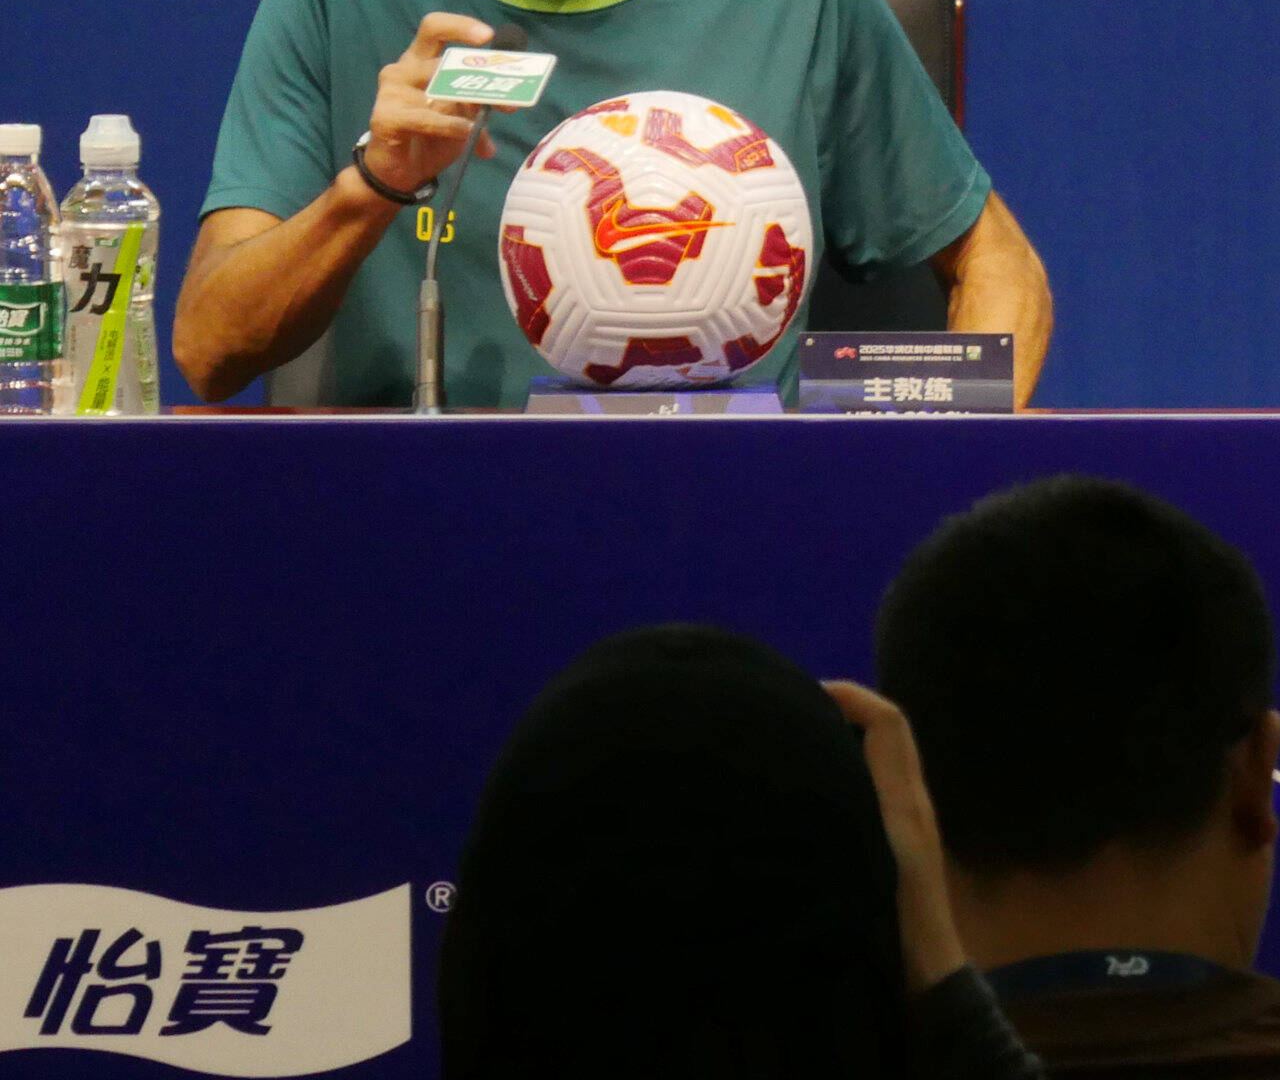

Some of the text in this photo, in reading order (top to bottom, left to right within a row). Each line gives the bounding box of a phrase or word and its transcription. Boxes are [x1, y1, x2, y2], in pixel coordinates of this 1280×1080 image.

[863, 377, 953, 402] 主教练
[23, 926, 304, 1037] 怡寶
